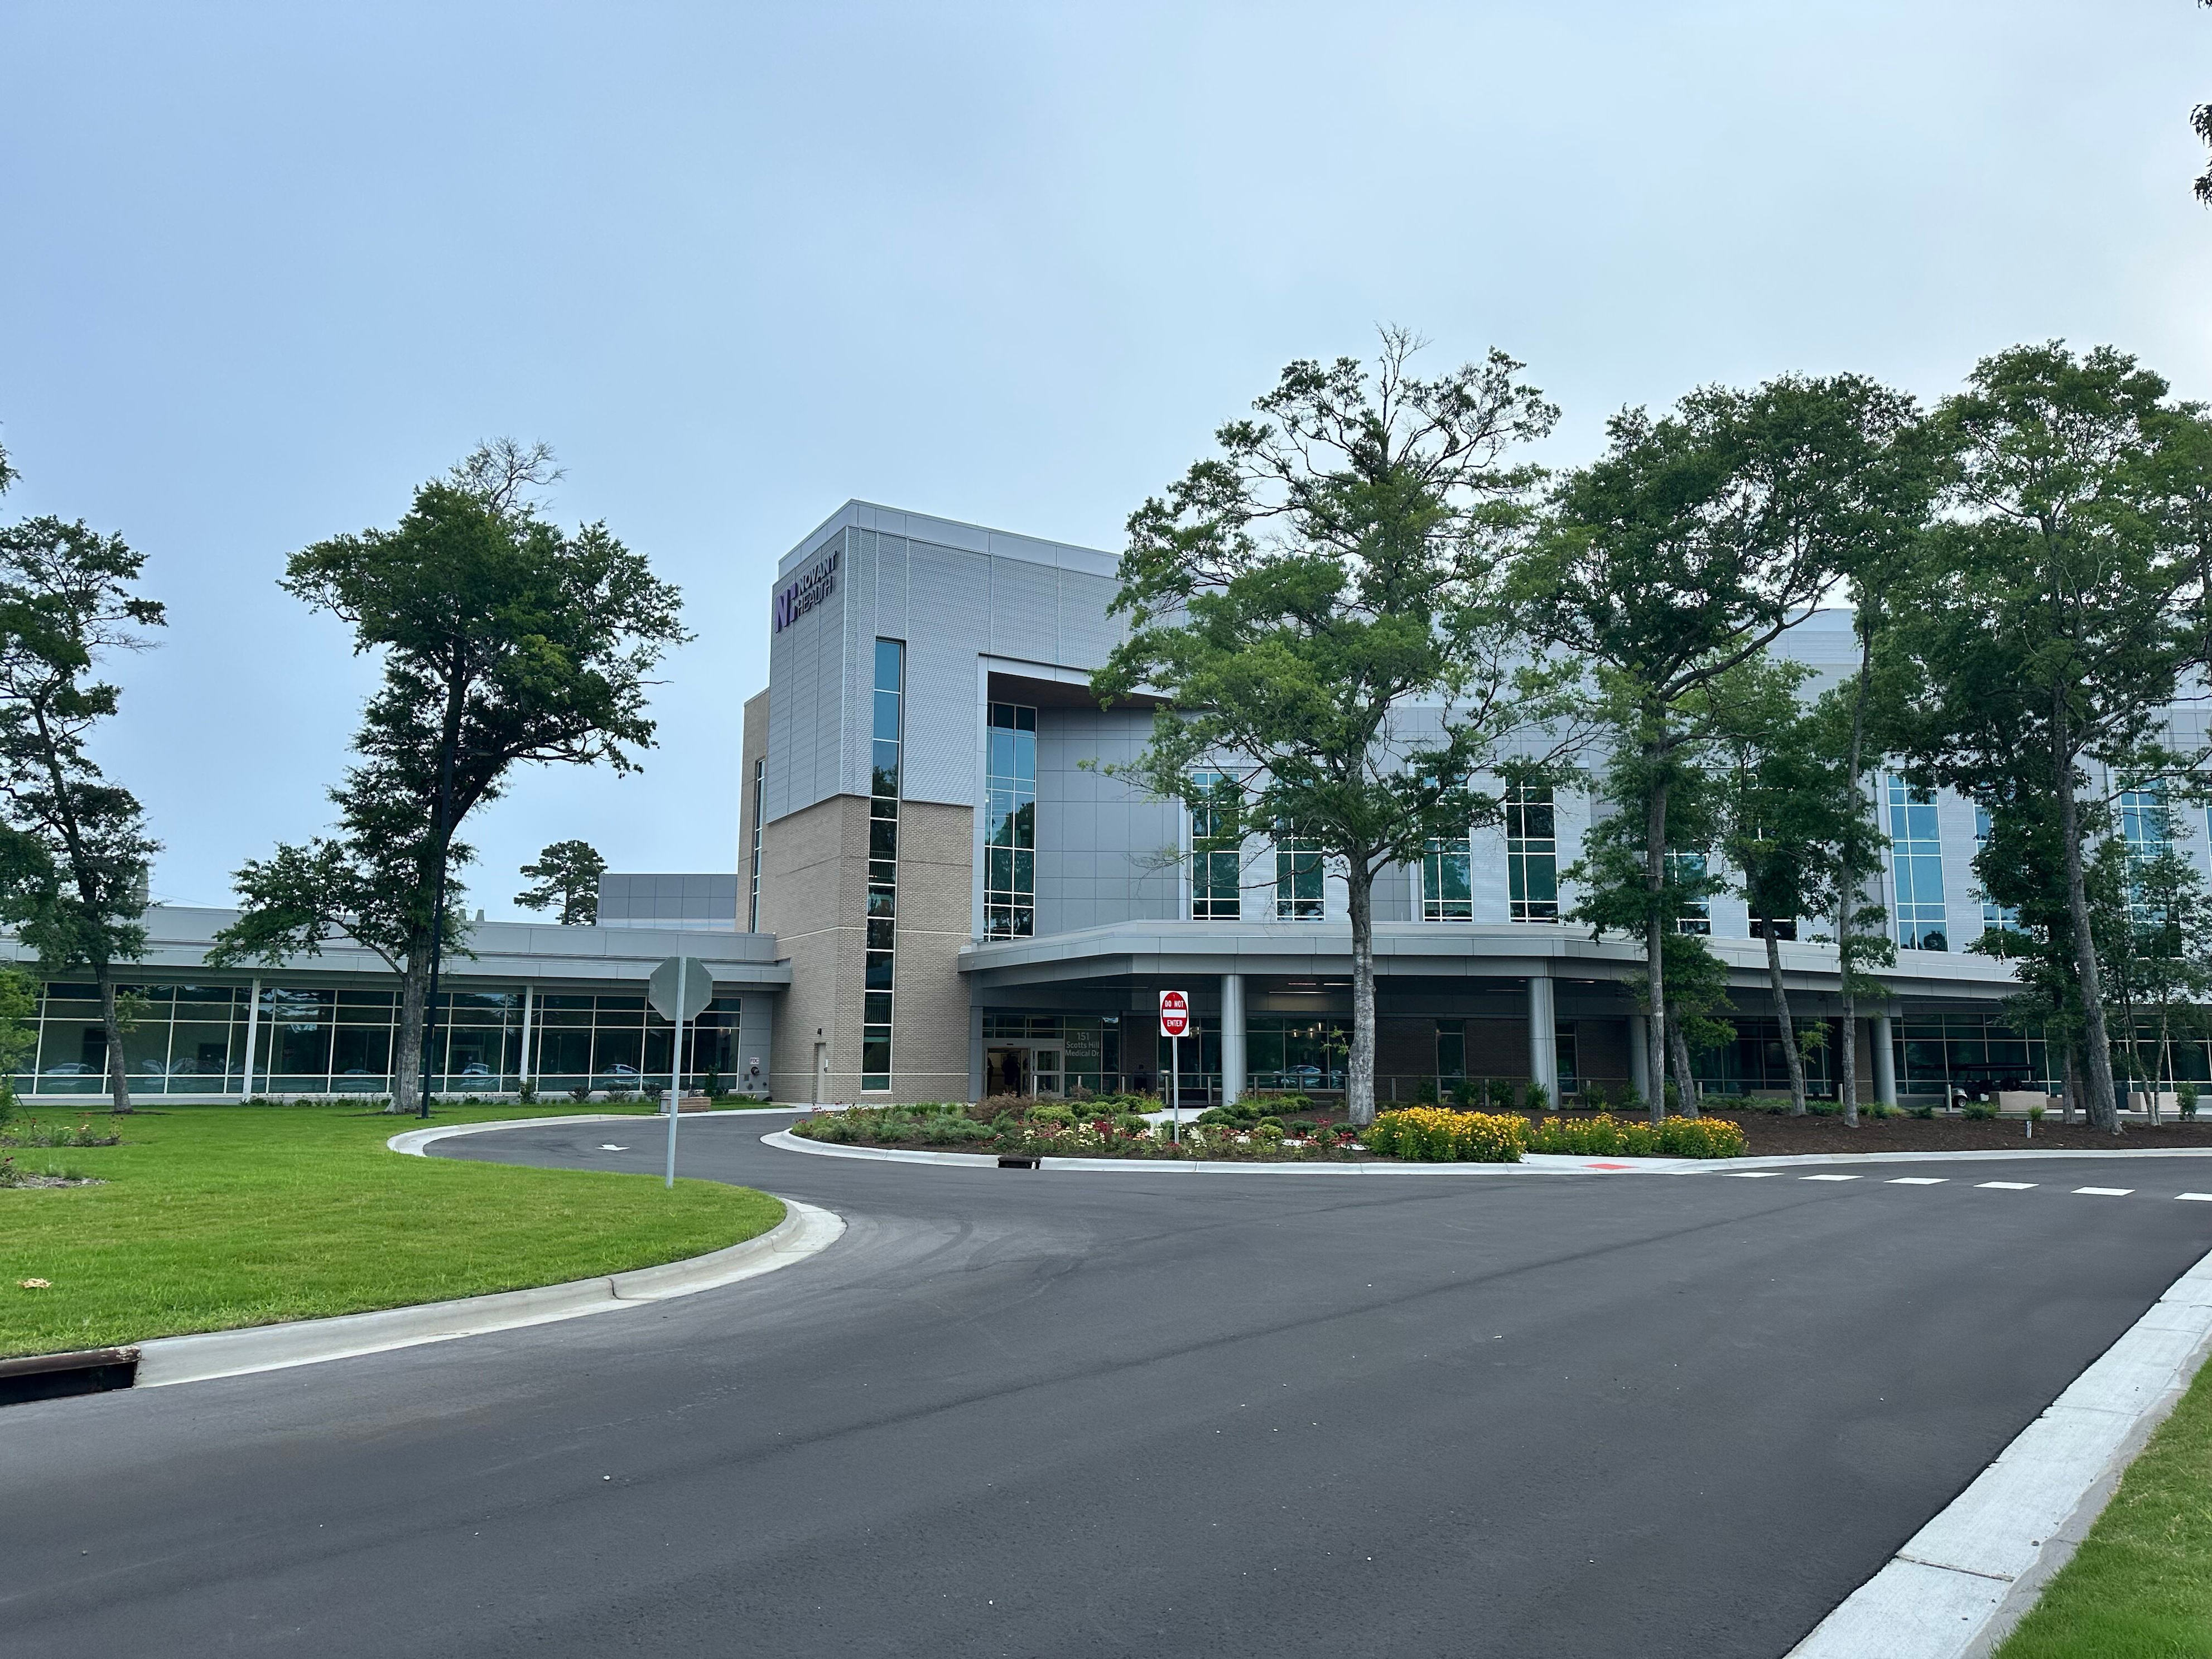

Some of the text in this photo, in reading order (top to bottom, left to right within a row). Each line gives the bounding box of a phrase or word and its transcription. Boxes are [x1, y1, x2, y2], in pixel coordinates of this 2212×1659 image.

[797, 550, 837, 596] NOVANT
[797, 575, 833, 616] HEALTH
[1077, 1032, 1089, 1041] 151
